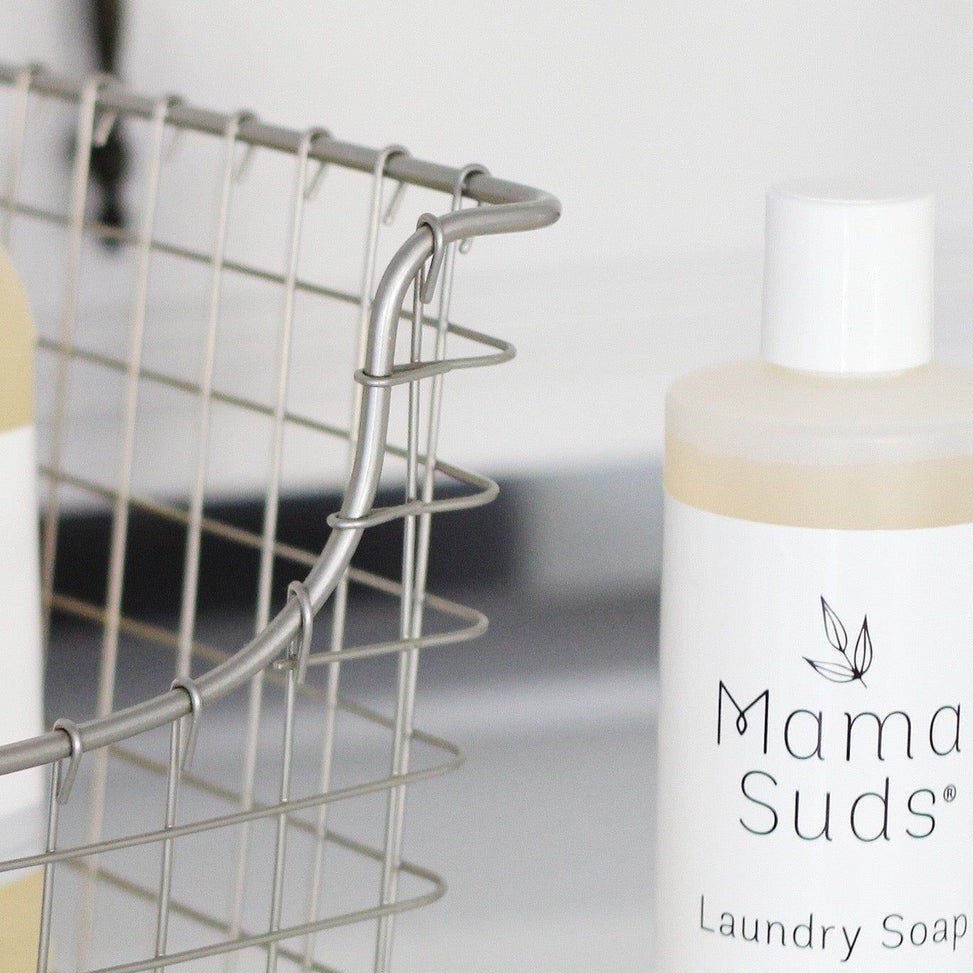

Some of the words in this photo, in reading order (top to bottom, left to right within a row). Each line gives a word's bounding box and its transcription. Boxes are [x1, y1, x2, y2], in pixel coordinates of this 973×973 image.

[716, 679, 962, 762] Mama
[699, 894, 862, 963] Laundry
[881, 912, 968, 952] Soap
